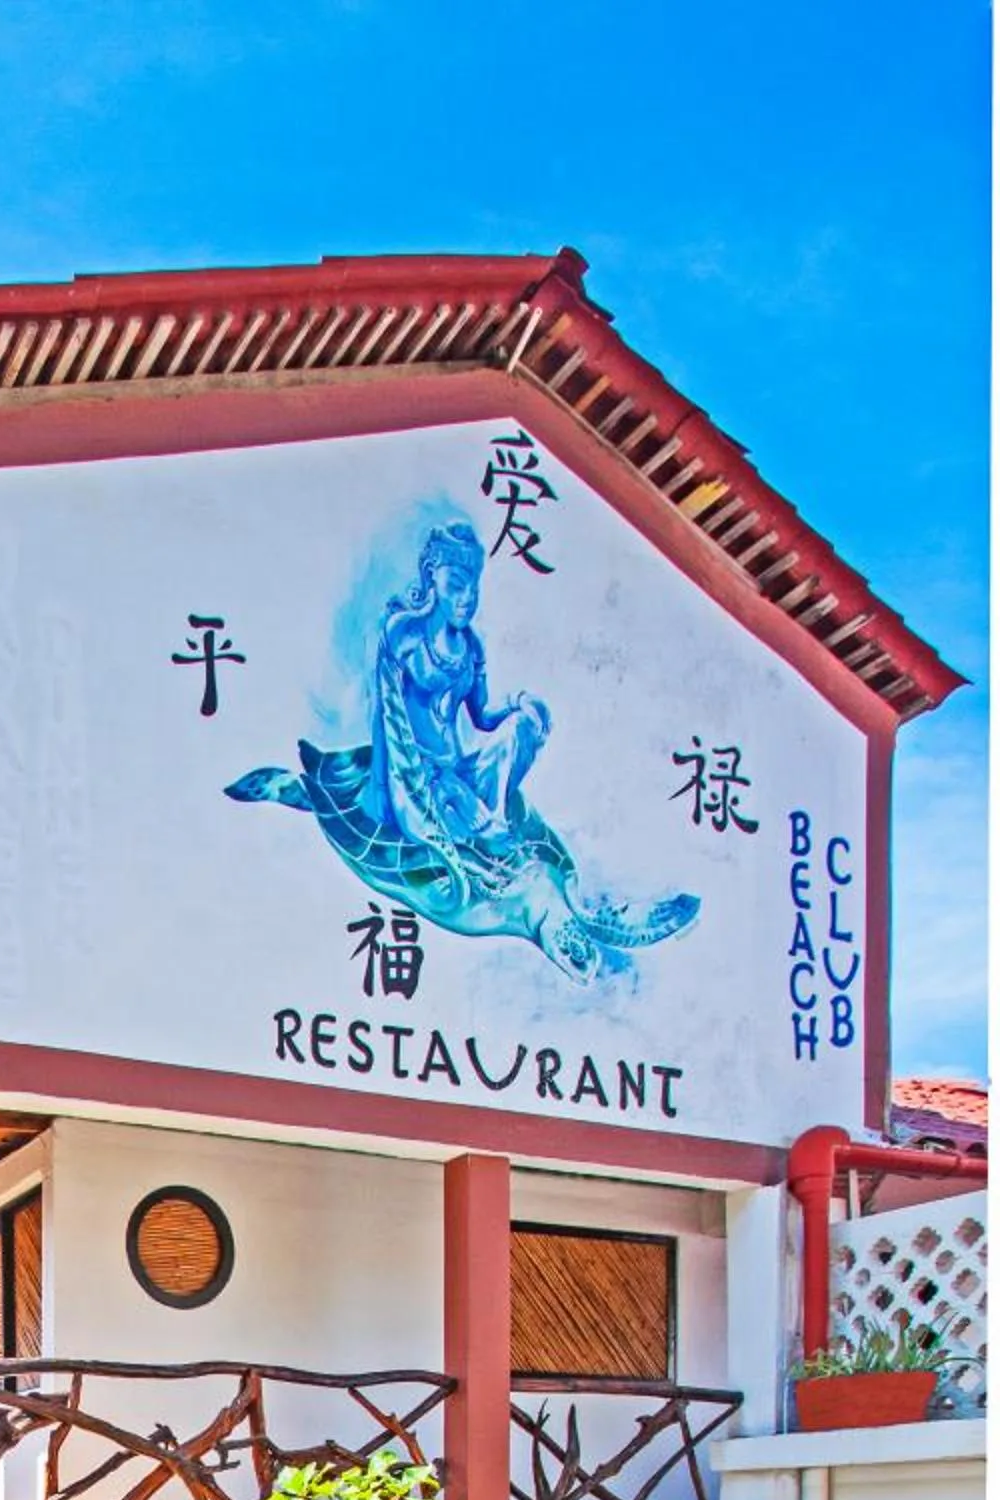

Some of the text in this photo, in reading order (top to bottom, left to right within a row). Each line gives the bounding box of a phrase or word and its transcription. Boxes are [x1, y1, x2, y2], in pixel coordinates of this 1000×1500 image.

[171, 613, 247, 717] 平
[347, 901, 425, 1001] 福
[787, 810, 820, 1062] BEACH
[822, 836, 860, 1049] CLUB
[273, 1008, 684, 1119] RESTAURANT
